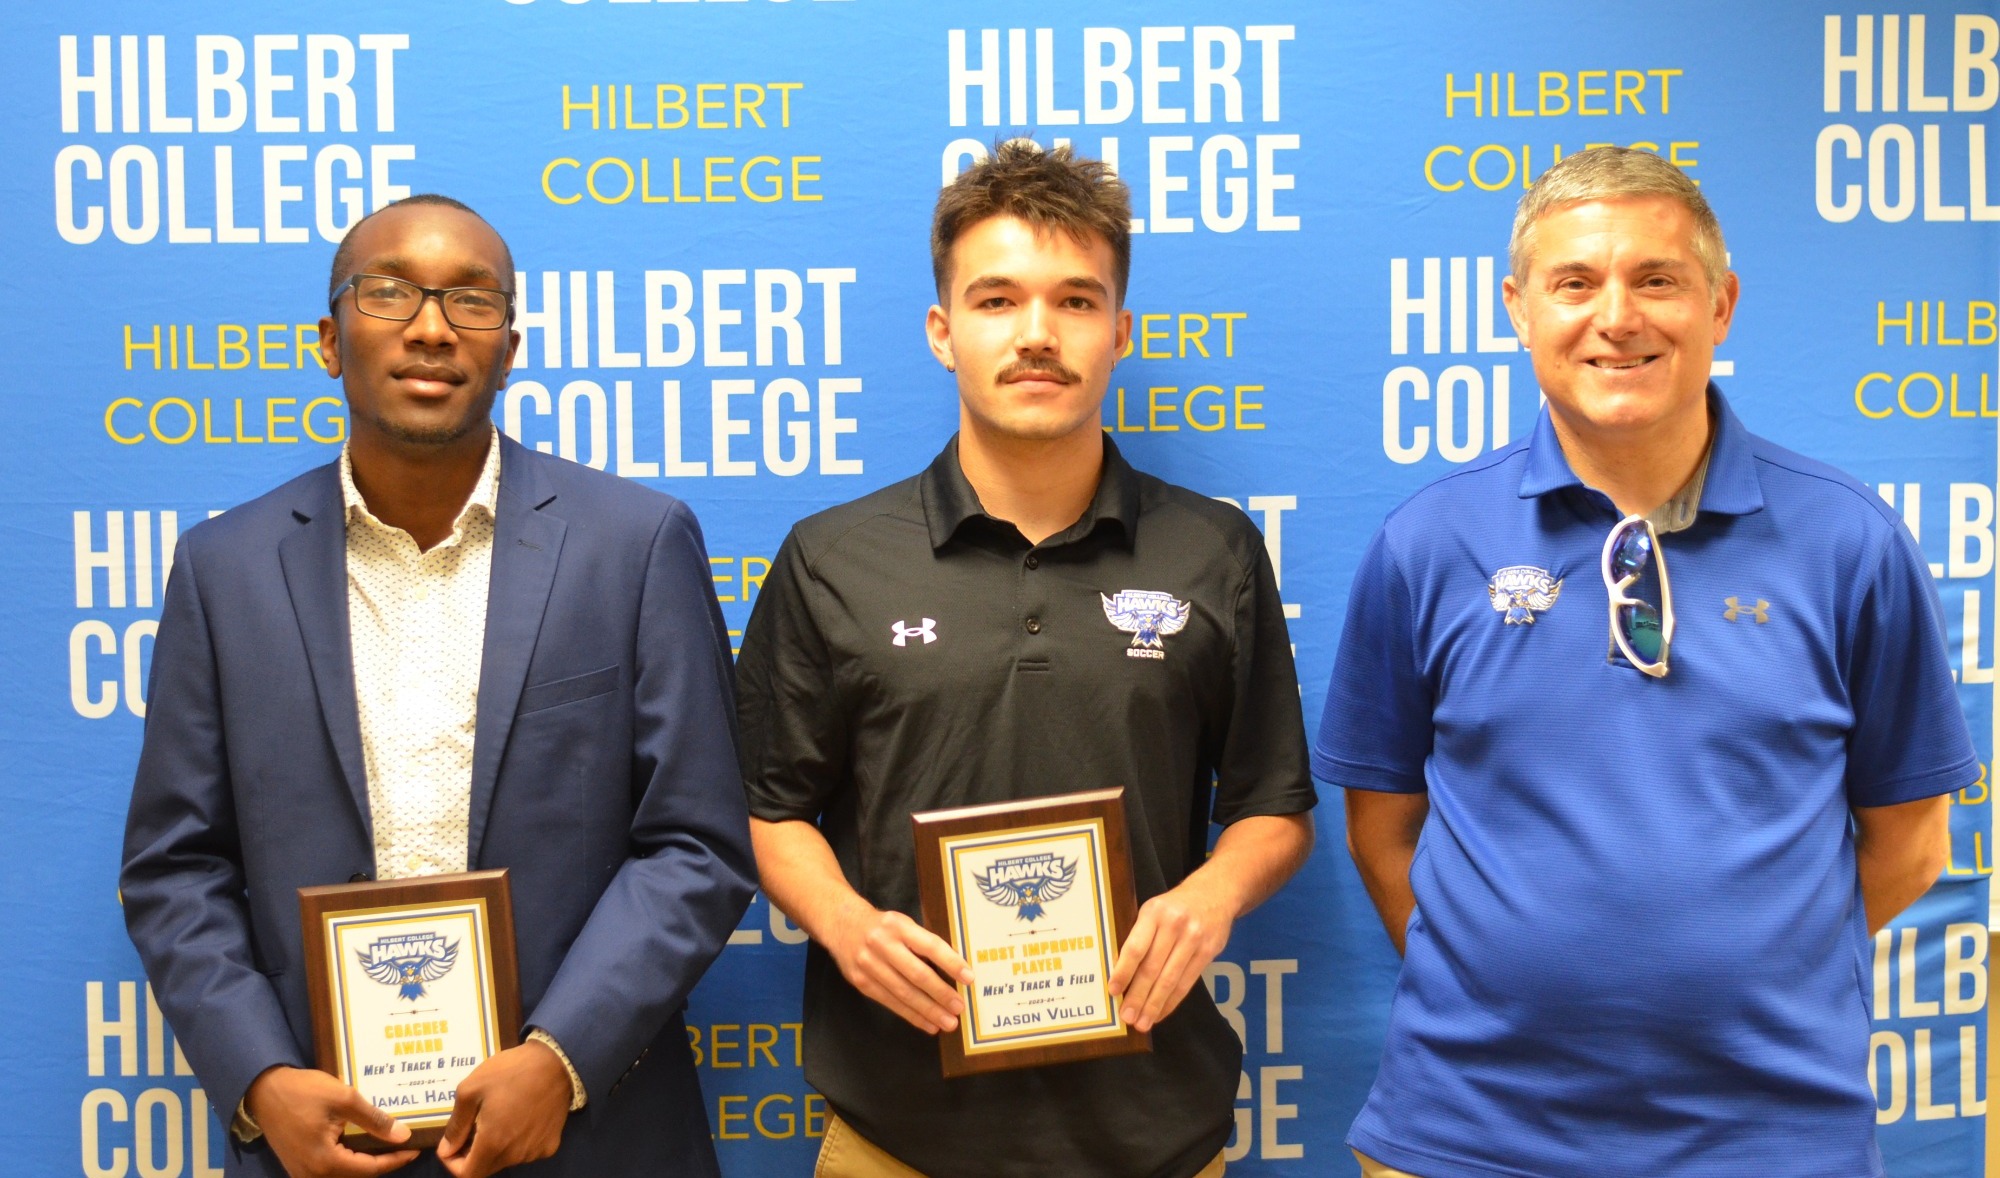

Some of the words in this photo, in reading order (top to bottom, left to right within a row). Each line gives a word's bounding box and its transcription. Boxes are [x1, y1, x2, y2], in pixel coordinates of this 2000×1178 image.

[59, 33, 410, 133] HILBERT
[947, 24, 1296, 127] HILBERT
[1445, 69, 1683, 118] HILBERT
[562, 82, 803, 130] HILBERT
[541, 155, 823, 205] COLLEGE
[511, 267, 857, 369] HILBERT
[124, 323, 328, 370] HILBER
[103, 396, 346, 445] COLLEG
[1102, 384, 1266, 432] LEGE
[503, 377, 864, 478] COLLEGE
[1494, 573, 1551, 595] HAWKS
[1116, 597, 1179, 618] HAWKS
[1126, 648, 1164, 659] SOCCER
[989, 859, 1063, 888] HAWKS
[371, 938, 447, 966] HAWKS
[976, 945, 1015, 963] MOST
[1022, 935, 1094, 957] IMPROVED
[1012, 957, 1063, 976] PLAYER
[384, 1019, 449, 1040] COACHES
[393, 1037, 444, 1057] AWARD
[424, 1089, 457, 1103] HAR
